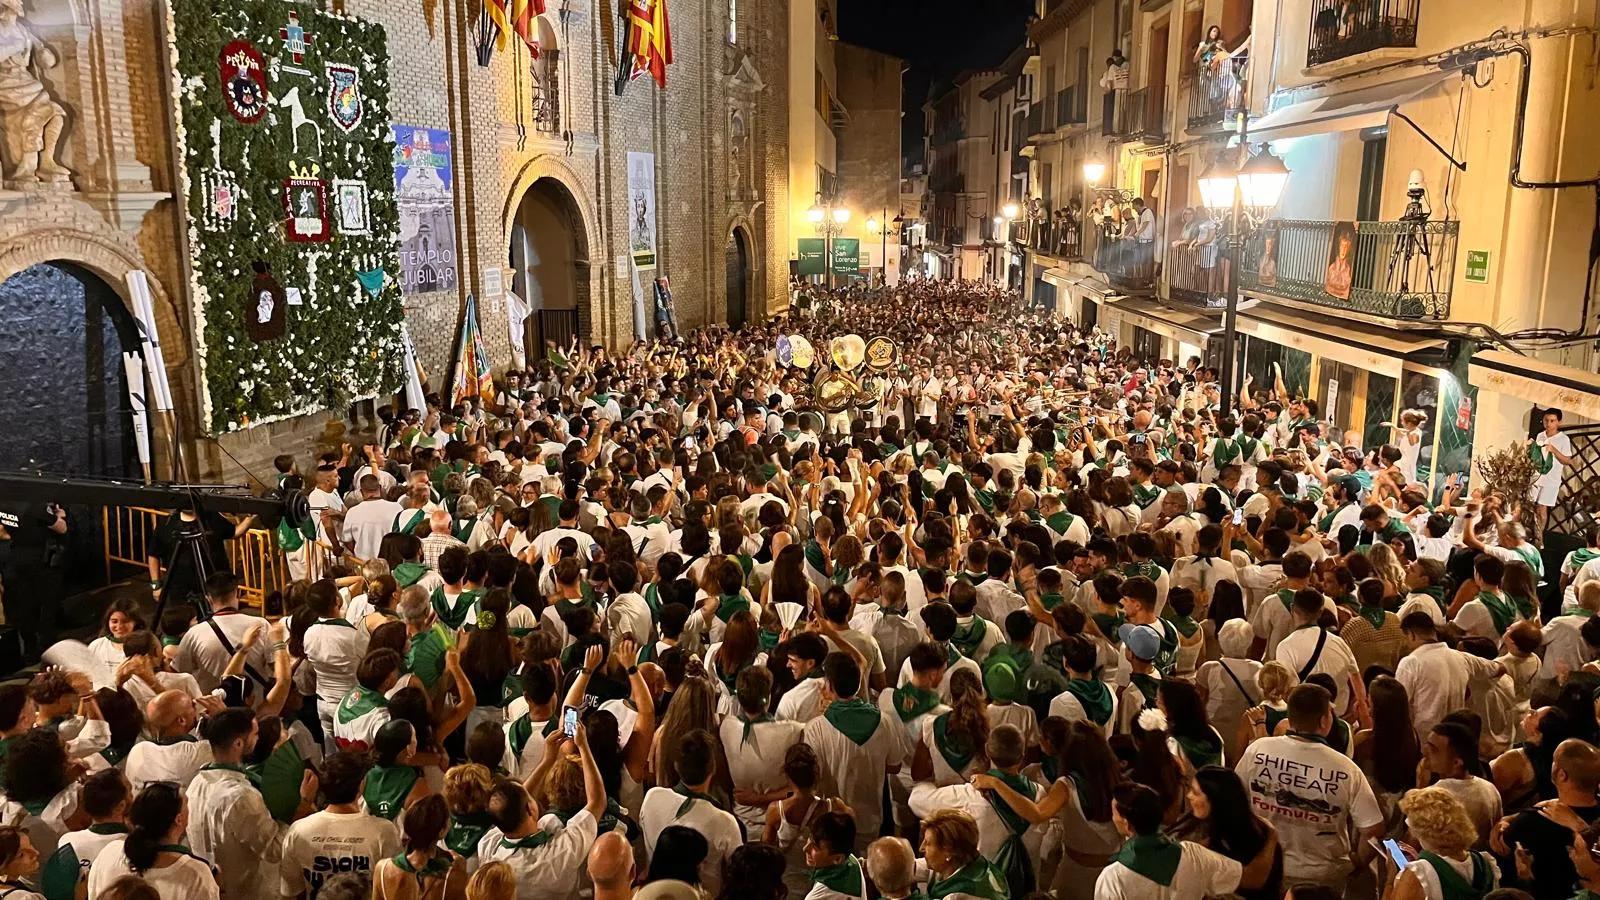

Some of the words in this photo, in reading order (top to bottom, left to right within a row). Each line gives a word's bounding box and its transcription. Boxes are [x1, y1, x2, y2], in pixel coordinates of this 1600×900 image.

[400, 249, 452, 265] TEMPLO
[403, 267, 453, 286] JUBILAR
[1254, 753, 1314, 776] SHIFT
[1319, 768, 1348, 783] UP
[1259, 767, 1272, 780] A
[1278, 772, 1339, 796] GEAR
[1252, 797, 1320, 823] Formula
